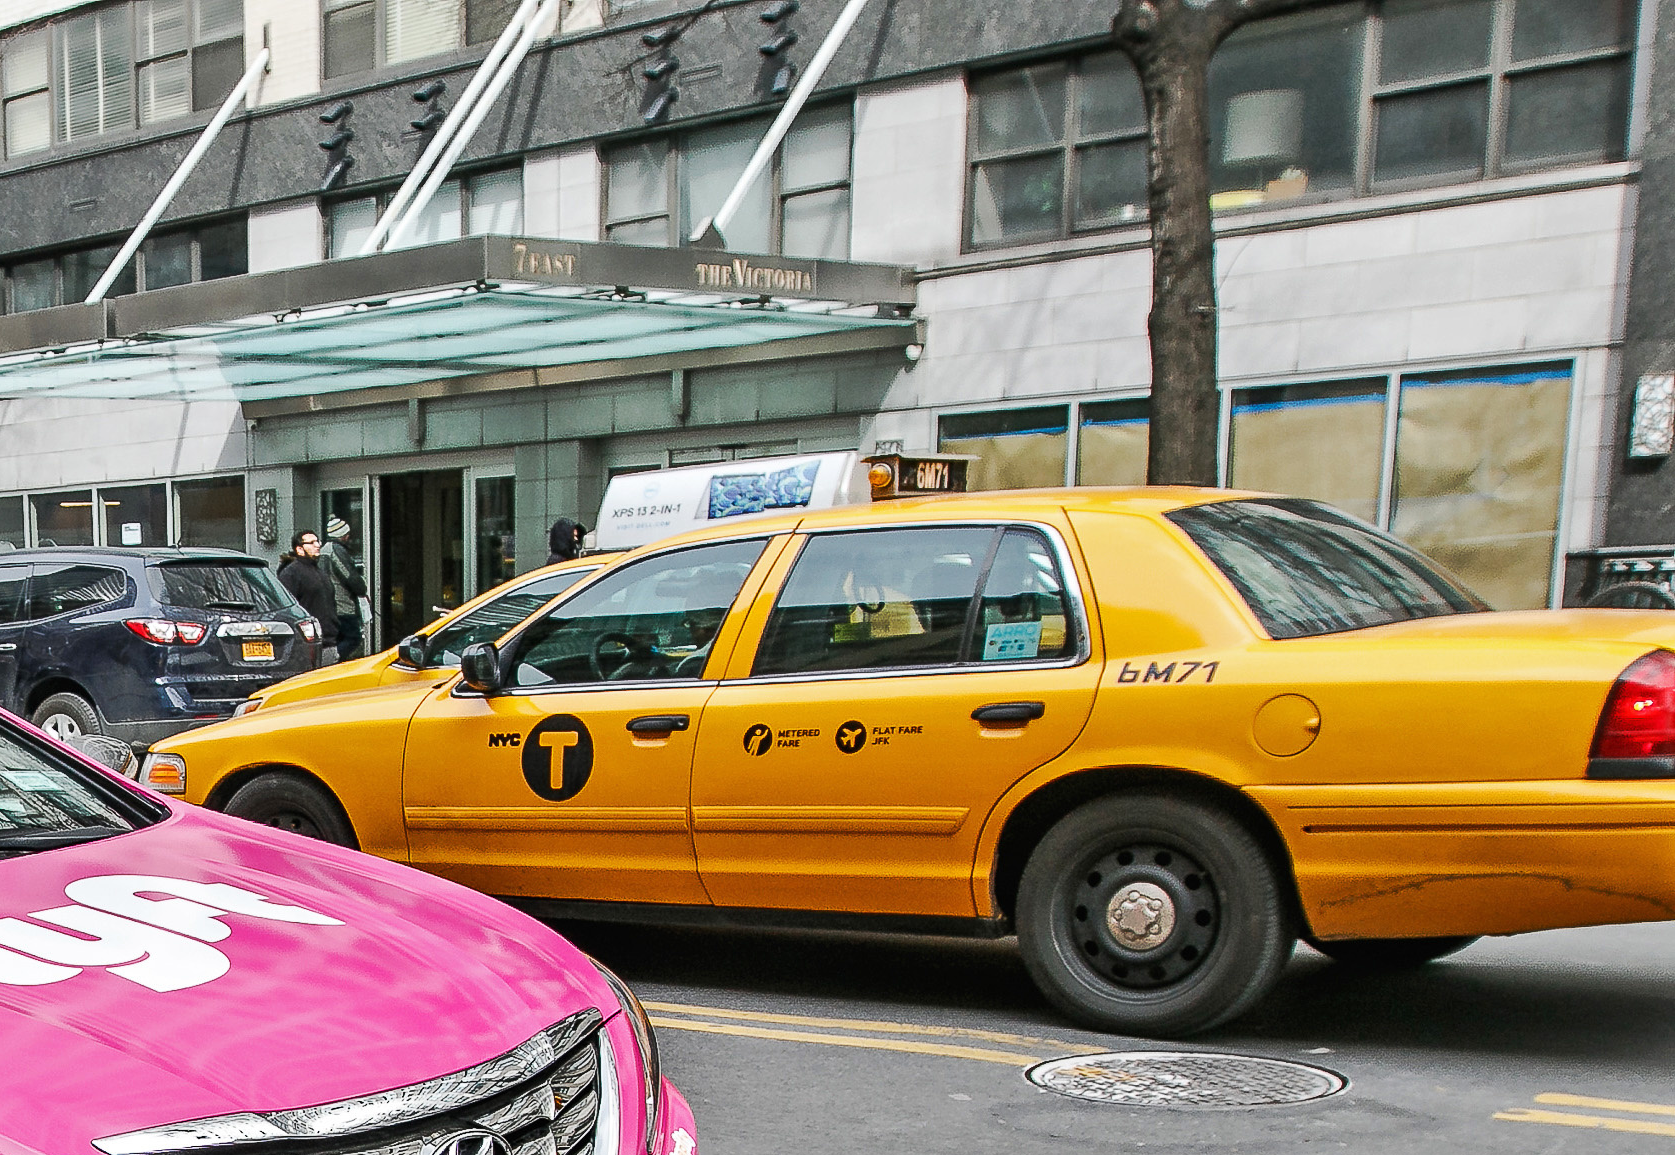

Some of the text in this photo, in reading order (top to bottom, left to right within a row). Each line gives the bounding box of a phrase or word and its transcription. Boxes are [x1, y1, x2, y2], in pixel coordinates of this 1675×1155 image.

[529, 252, 575, 277] EAST
[696, 258, 812, 292] THE VICTORIA
[917, 461, 950, 489] 6M71
[612, 503, 682, 518] XPS 13 2-IN-1
[991, 623, 1038, 639] ARRO
[777, 729, 821, 739] METERED
[872, 725, 924, 736] FLAT FARE
[777, 739, 801, 748] FARE
[872, 736, 891, 746] JFK
[488, 730, 579, 790] NYC T
